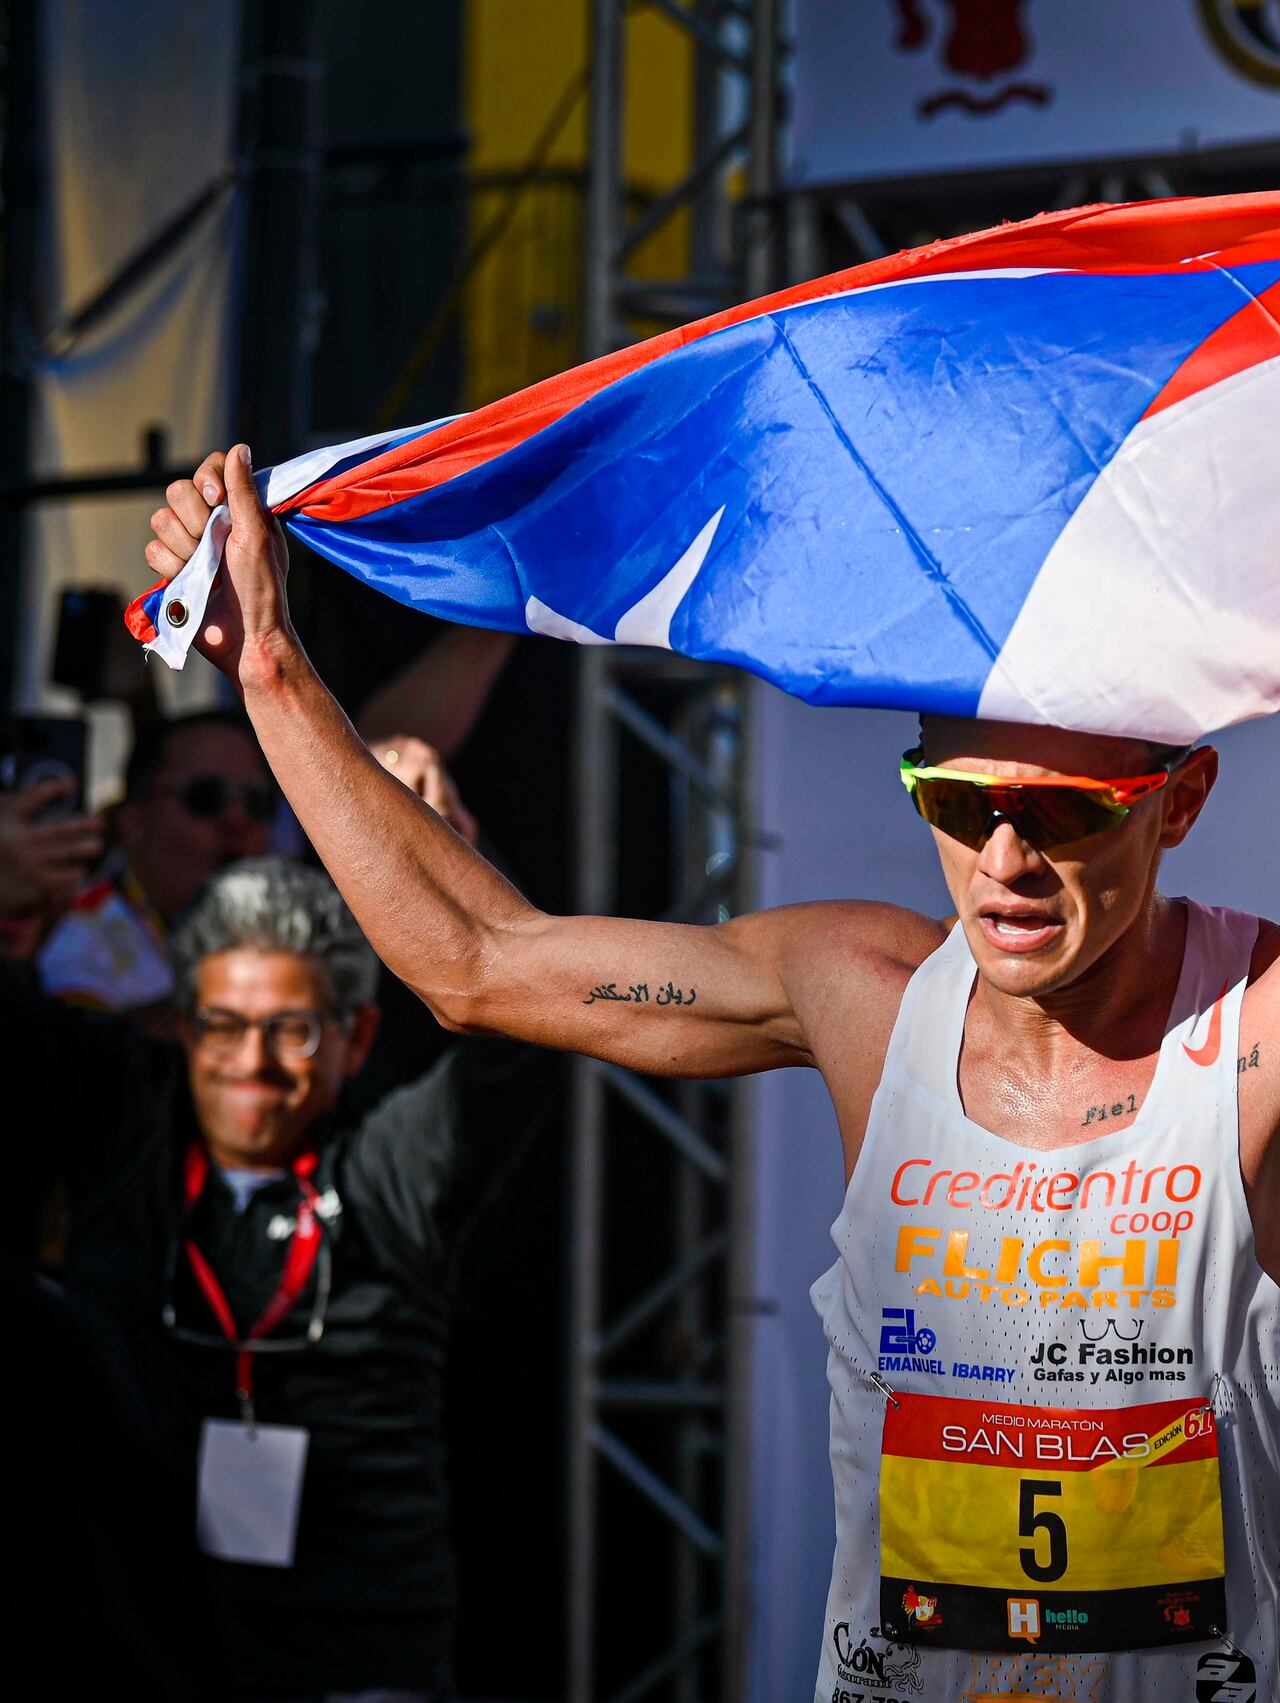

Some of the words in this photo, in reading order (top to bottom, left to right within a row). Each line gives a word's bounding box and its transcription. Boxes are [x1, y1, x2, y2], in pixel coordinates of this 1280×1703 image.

[1081, 1094, 1138, 1126] Fiel
[890, 1158, 1202, 1213] Credicentro
[1110, 1210, 1194, 1239] coop
[895, 1226, 1181, 1288] FLICHI
[914, 1278, 1029, 1306] AUTO
[1039, 1289, 1177, 1308] PARTS
[1030, 1342, 1067, 1365] JC
[1079, 1342, 1194, 1365] Fashion
[878, 1357, 946, 1376] EMANUEL
[952, 1363, 1016, 1383] IBARRY
[1034, 1368, 1085, 1382] Gafas
[1090, 1372, 1099, 1385] y
[1105, 1367, 1144, 1384] Algo
[1149, 1369, 1186, 1382] mas
[982, 1413, 1025, 1427] MEDIO
[1027, 1417, 1104, 1431] MARATÓN
[1153, 1424, 1182, 1450] EDICIÓN
[1183, 1407, 1213, 1440] 61
[942, 1425, 1023, 1458] SAN
[1036, 1432, 1150, 1462] BLAS
[1019, 1478, 1068, 1583] 5
[1046, 1608, 1089, 1624] hello
